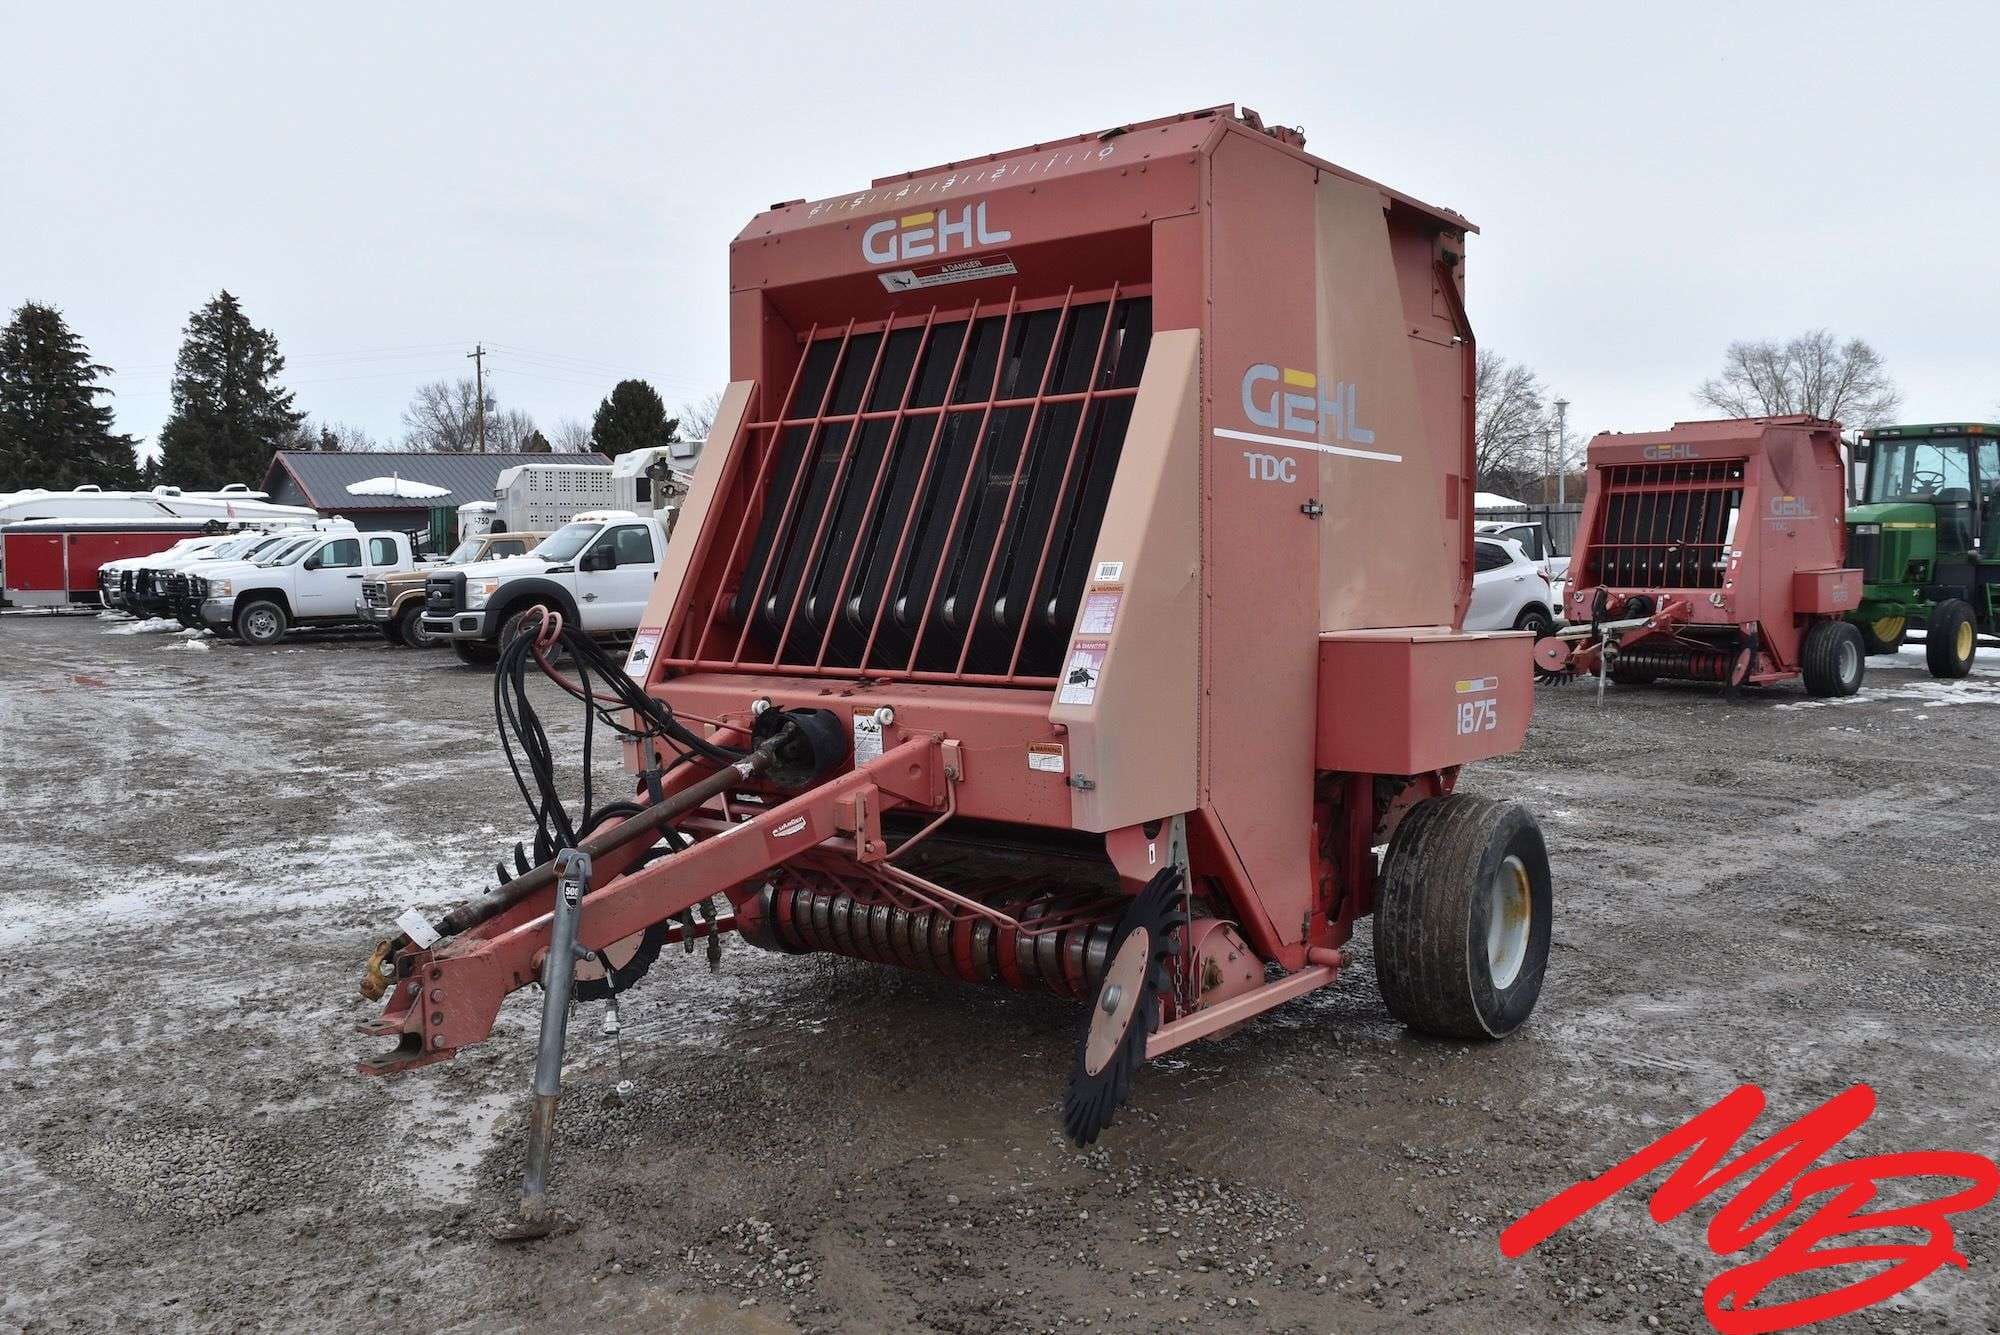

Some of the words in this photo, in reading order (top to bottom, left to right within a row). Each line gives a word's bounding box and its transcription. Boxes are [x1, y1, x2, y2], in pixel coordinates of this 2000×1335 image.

[862, 201, 1011, 264] GEHL
[948, 260, 983, 272] DANGER
[1242, 363, 1376, 444] GEHL
[1243, 452, 1297, 483] TDC
[1643, 443, 1699, 461] GEHL
[1457, 699, 1497, 736] 1875
